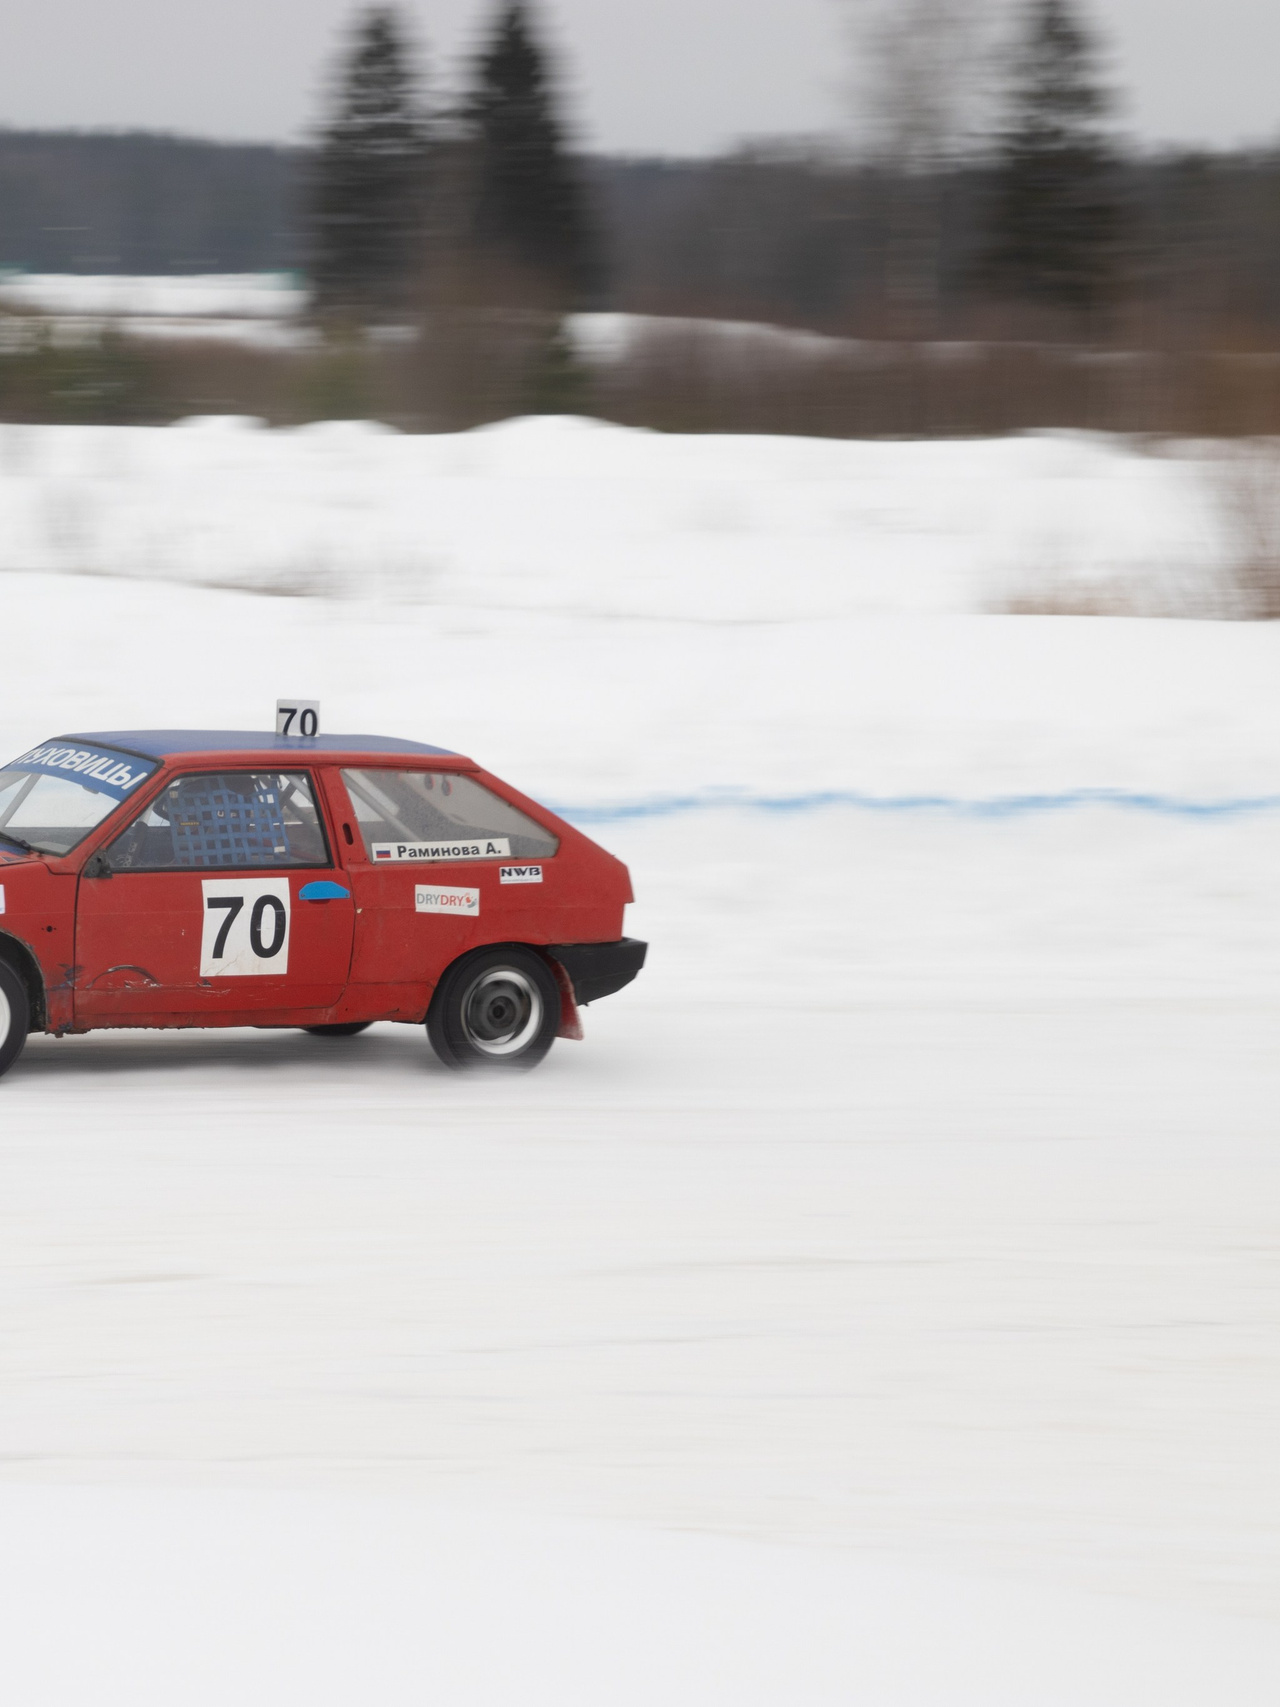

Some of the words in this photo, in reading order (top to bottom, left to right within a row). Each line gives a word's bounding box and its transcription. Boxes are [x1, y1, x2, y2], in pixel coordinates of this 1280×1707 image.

[279, 708, 318, 736] 70
[397, 845, 480, 858] Раминова
[485, 842, 502, 854] А.
[501, 867, 540, 877] NWB
[417, 893, 464, 906] DRYDRY
[207, 894, 287, 959] 70
